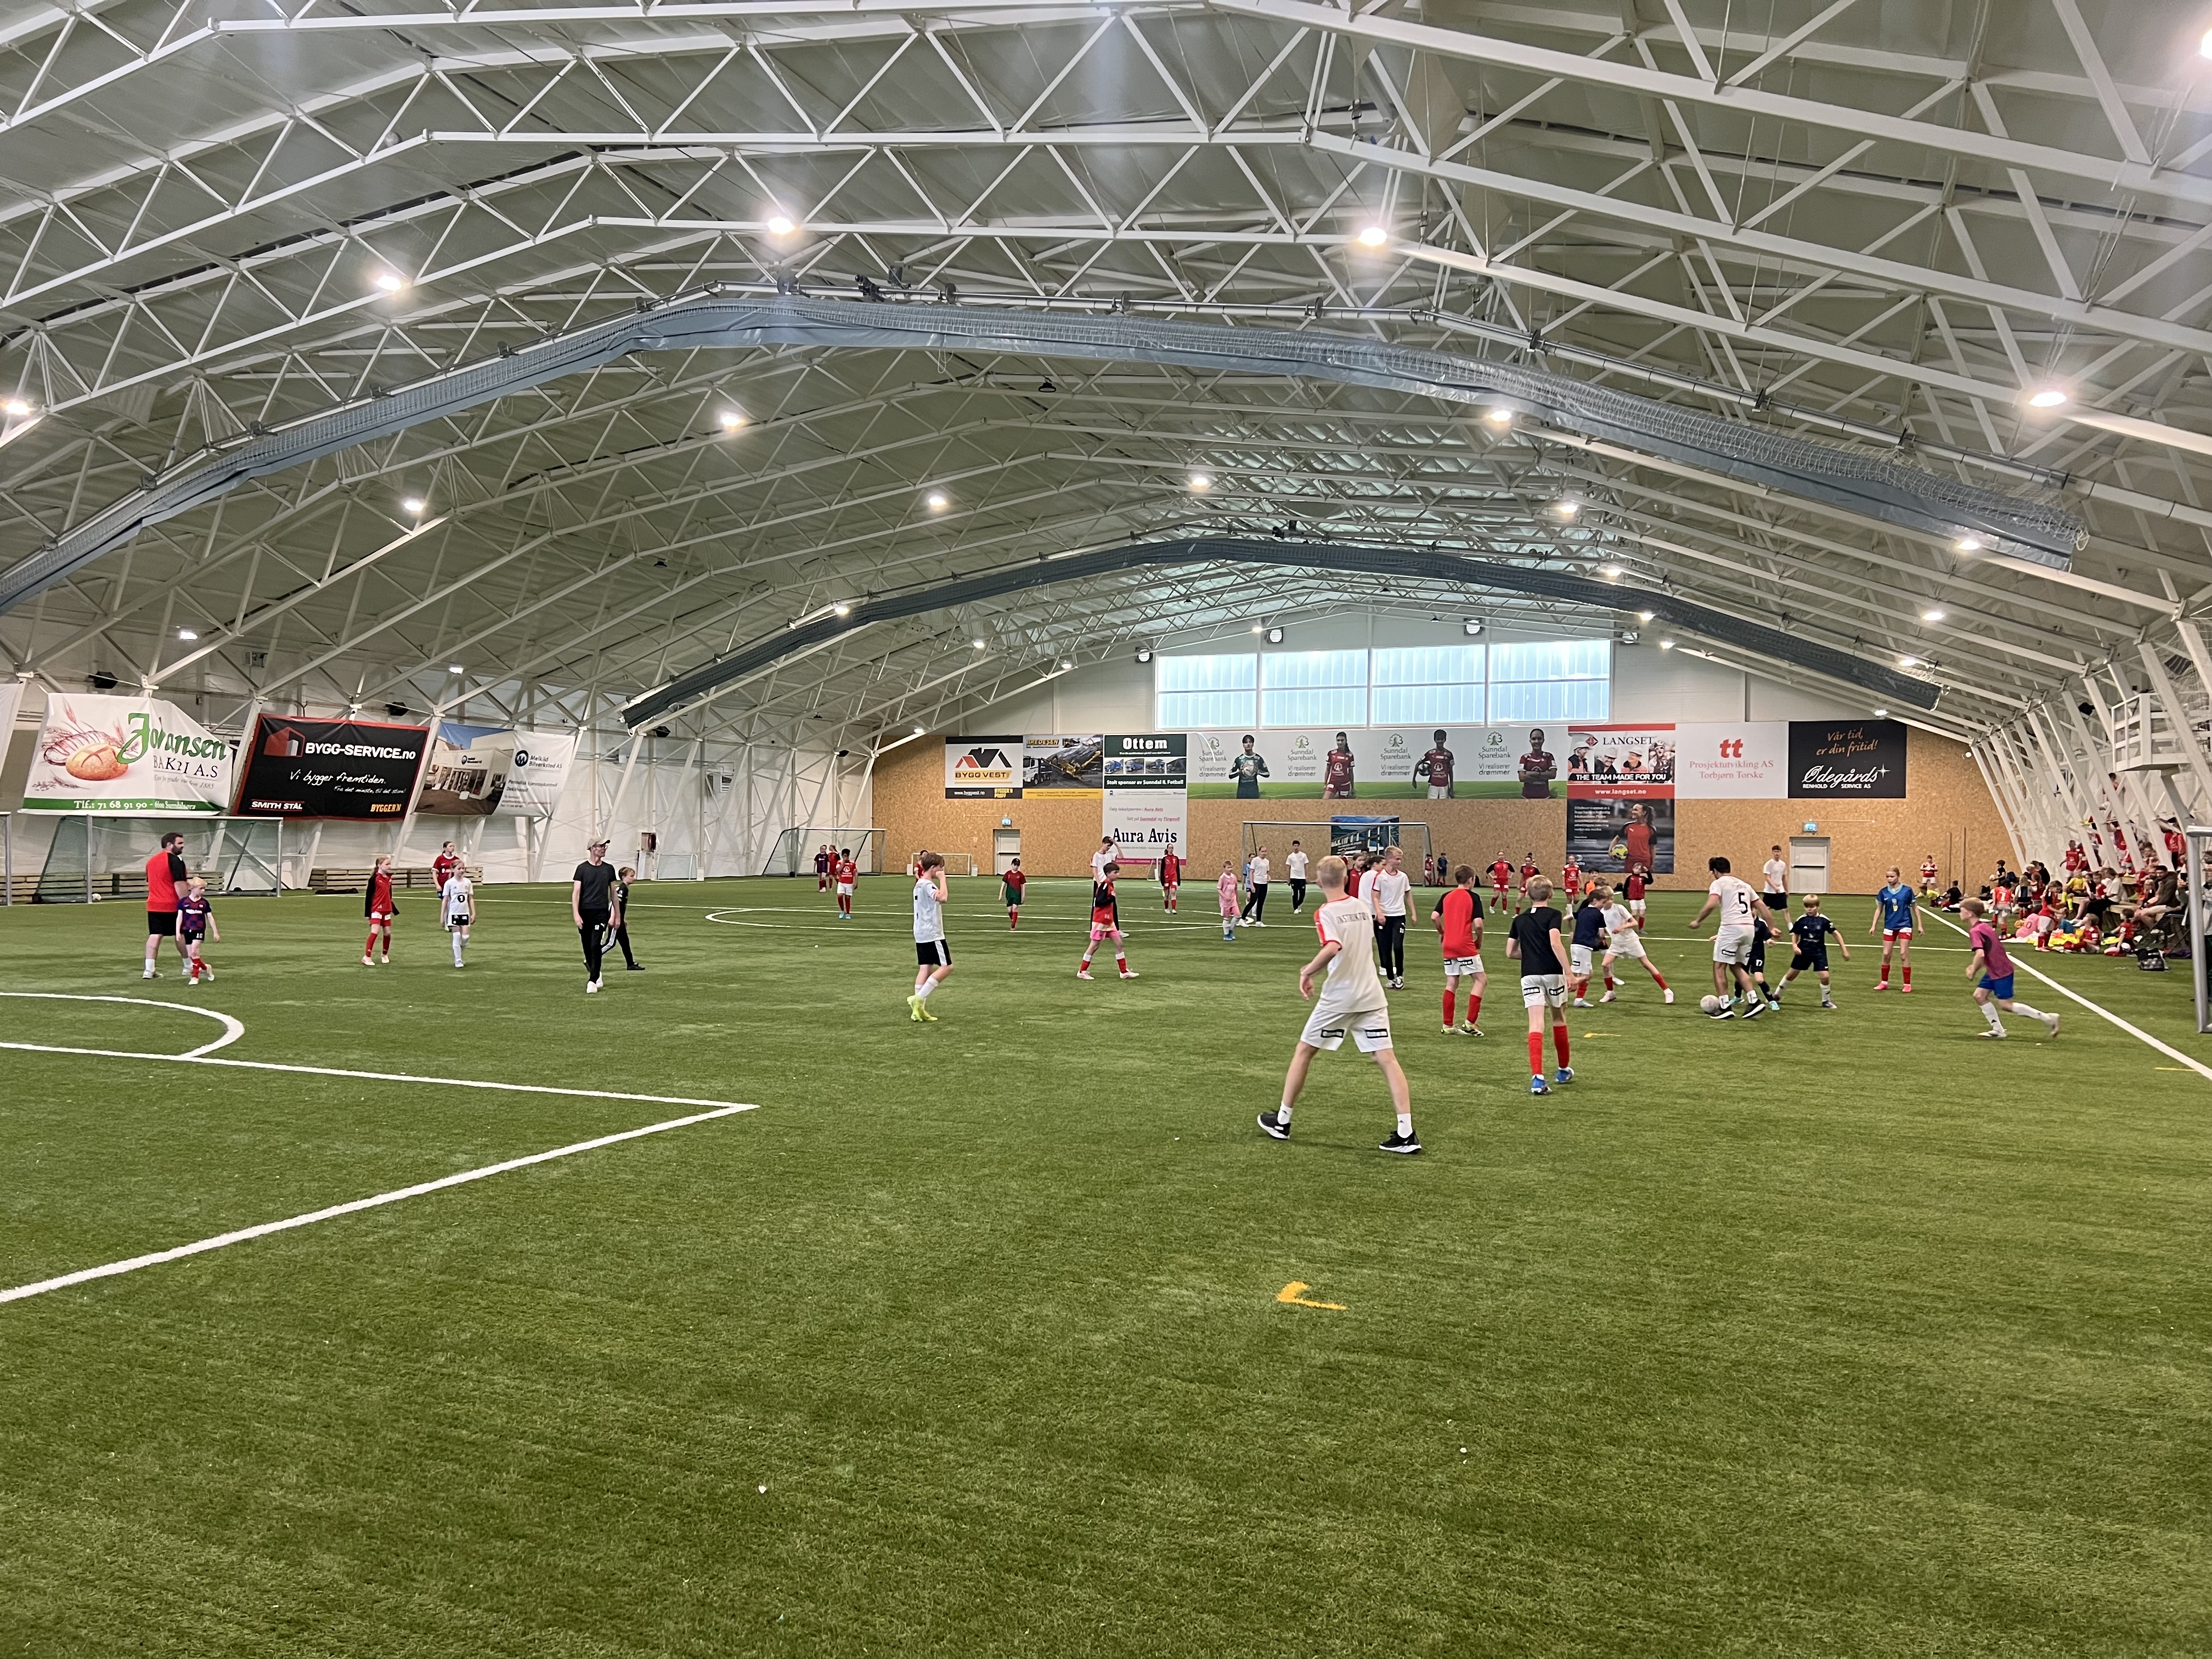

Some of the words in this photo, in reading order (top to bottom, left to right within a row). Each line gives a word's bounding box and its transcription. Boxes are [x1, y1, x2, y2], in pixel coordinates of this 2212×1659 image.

[1602, 736, 1654, 745] LANGSET
[1827, 731, 1846, 741] Vår
[1847, 727, 1864, 740] tid,
[305, 742, 416, 759] BYGG-SERVICE.no
[1122, 737, 1167, 749] Ottem
[1719, 738, 1743, 758] tt
[1816, 747, 1828, 755] er
[1829, 742, 1845, 755] din
[1847, 739, 1878, 757] fritid!
[1690, 760, 1759, 770] Prosjektutvikling
[290, 769, 301, 780] Vi
[303, 770, 334, 786] bygger
[336, 772, 386, 784] fremtiden.
[1699, 771, 1734, 781] Torbjørn
[1802, 765, 1878, 788] Ødegårds
[74, 800, 95, 809] Tlf.:
[109, 800, 121, 809] 68
[251, 801, 282, 809] SMITH
[1113, 827, 1144, 843] Aura
[1148, 828, 1177, 843] Avis
[1737, 892, 1748, 915] 5
